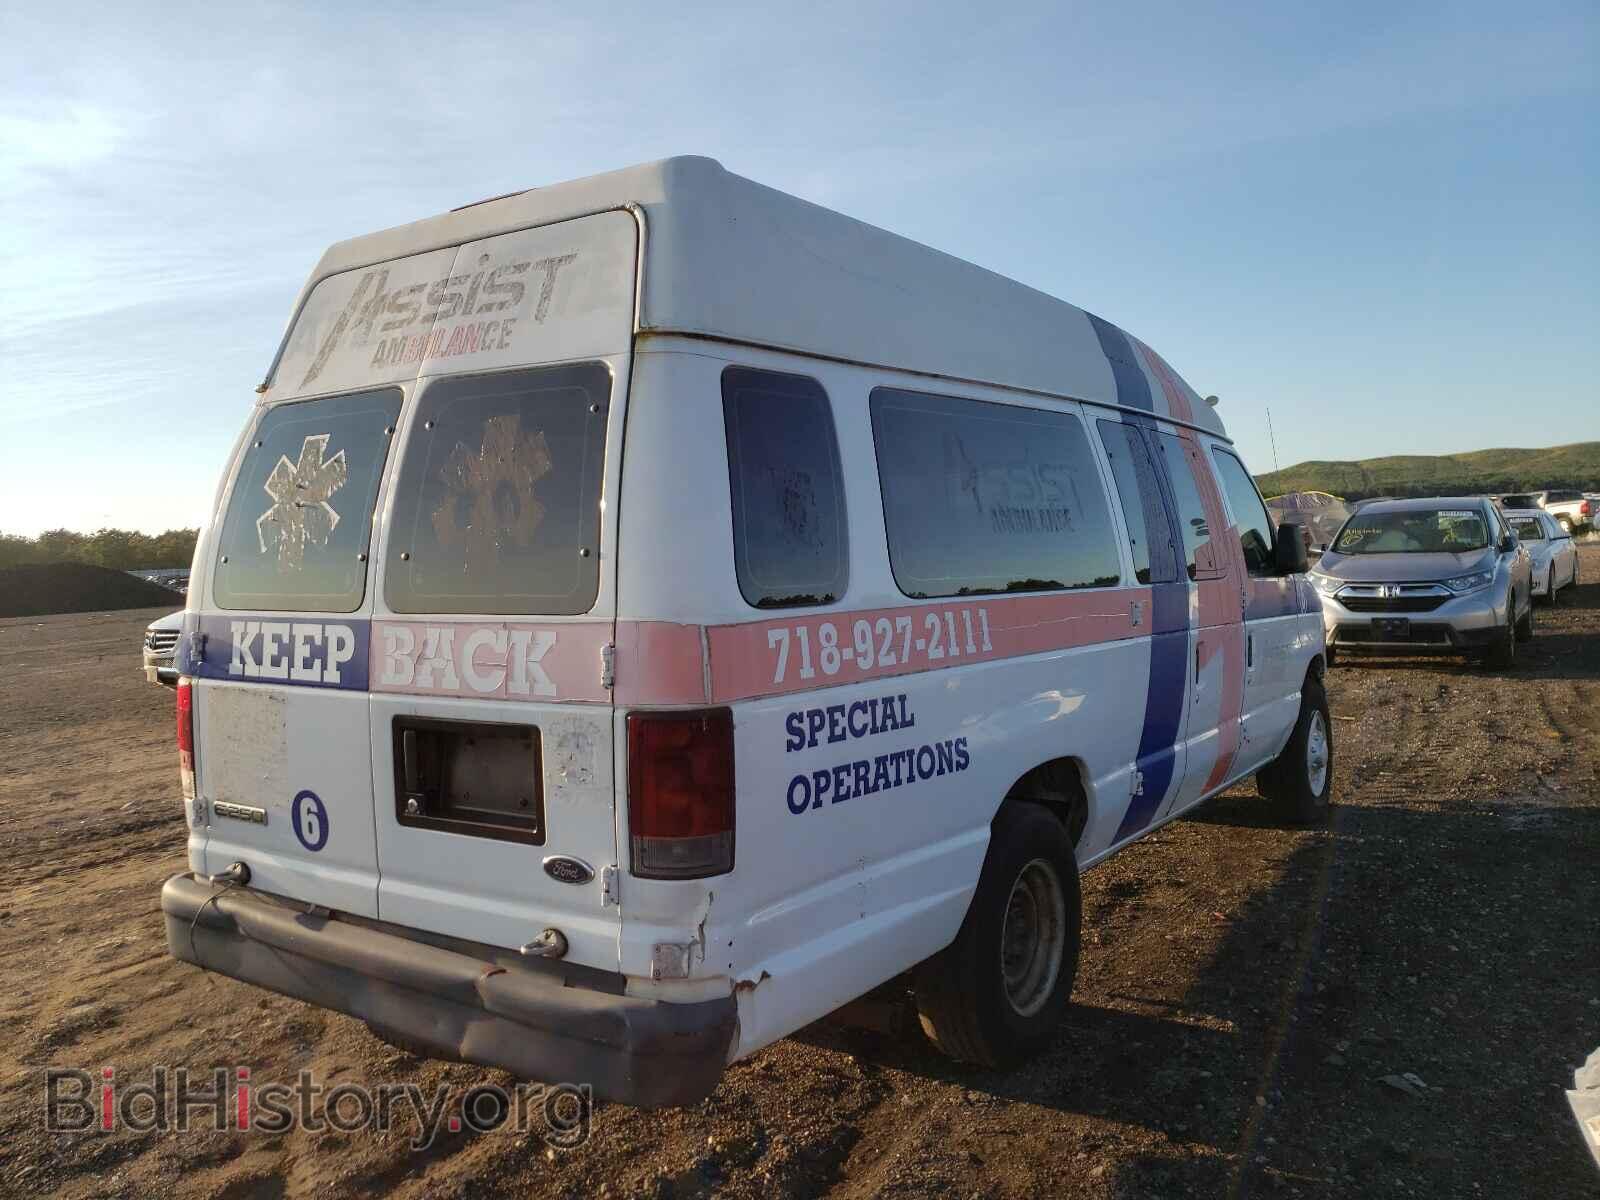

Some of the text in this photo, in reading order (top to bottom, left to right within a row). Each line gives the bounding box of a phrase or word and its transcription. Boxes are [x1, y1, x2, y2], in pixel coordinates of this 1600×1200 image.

[370, 317, 518, 369] AMBULANCE
[229, 620, 557, 697] KEEP BACK
[767, 608, 993, 684] 718-927-2111
[785, 694, 915, 752] SPECIAL
[786, 737, 970, 815] OPERATIONS
[300, 797, 321, 845] 6
